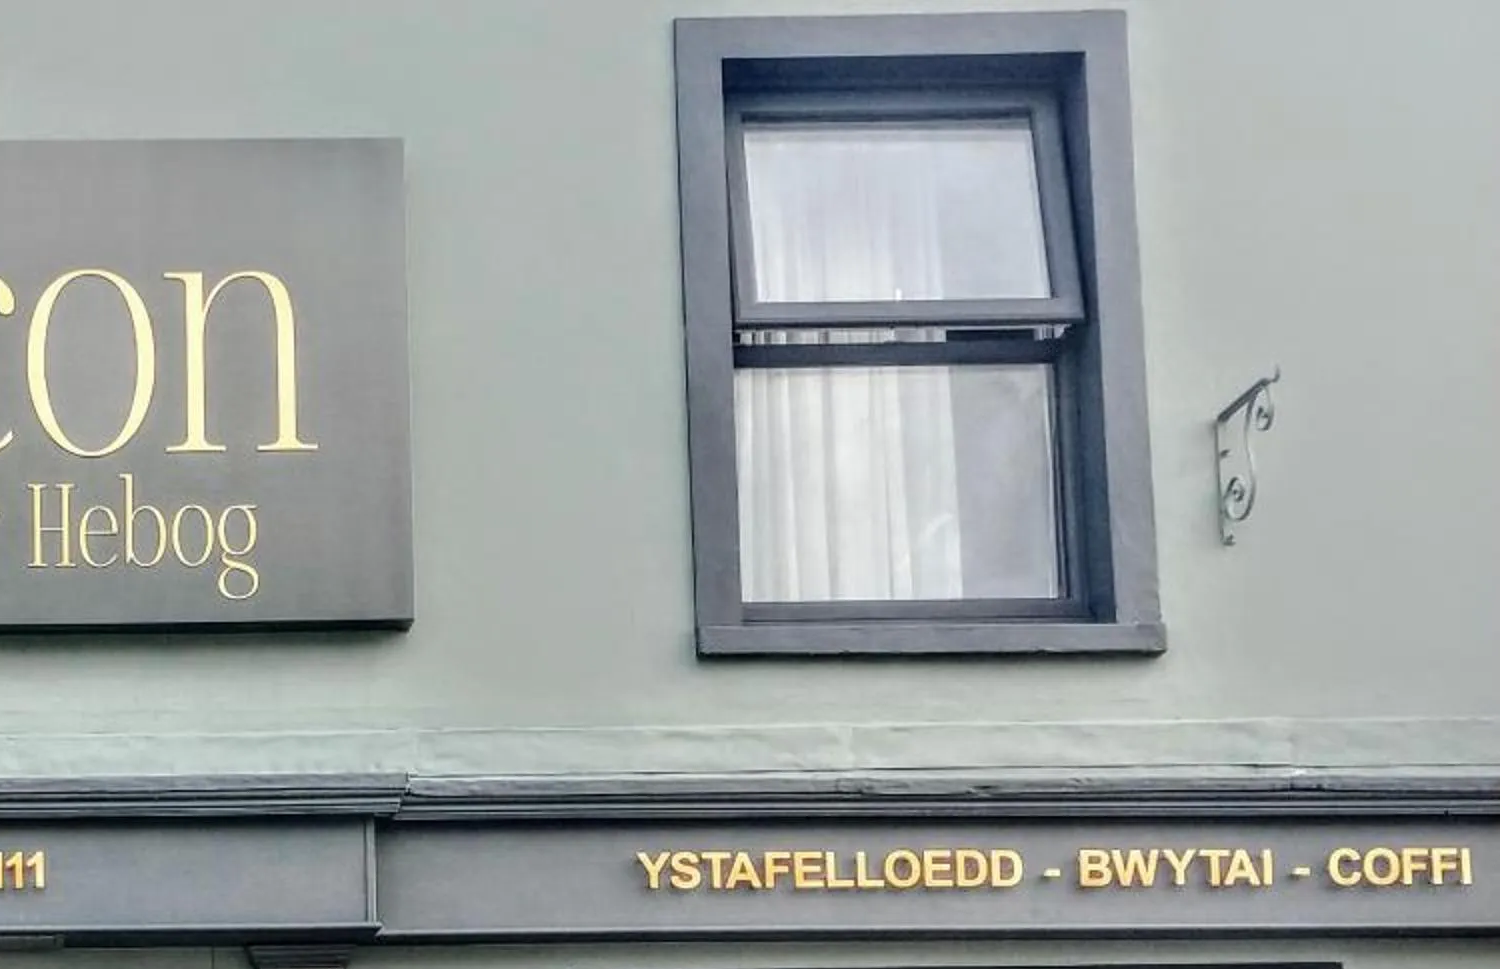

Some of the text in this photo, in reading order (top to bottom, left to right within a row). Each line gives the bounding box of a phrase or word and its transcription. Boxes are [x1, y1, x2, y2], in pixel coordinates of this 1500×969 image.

[27, 473, 262, 601] Hebog
[635, 849, 1024, 890] YSTAFELLOEDD
[1078, 847, 1275, 889] BWYTAI
[1327, 847, 1474, 888] COFFI
